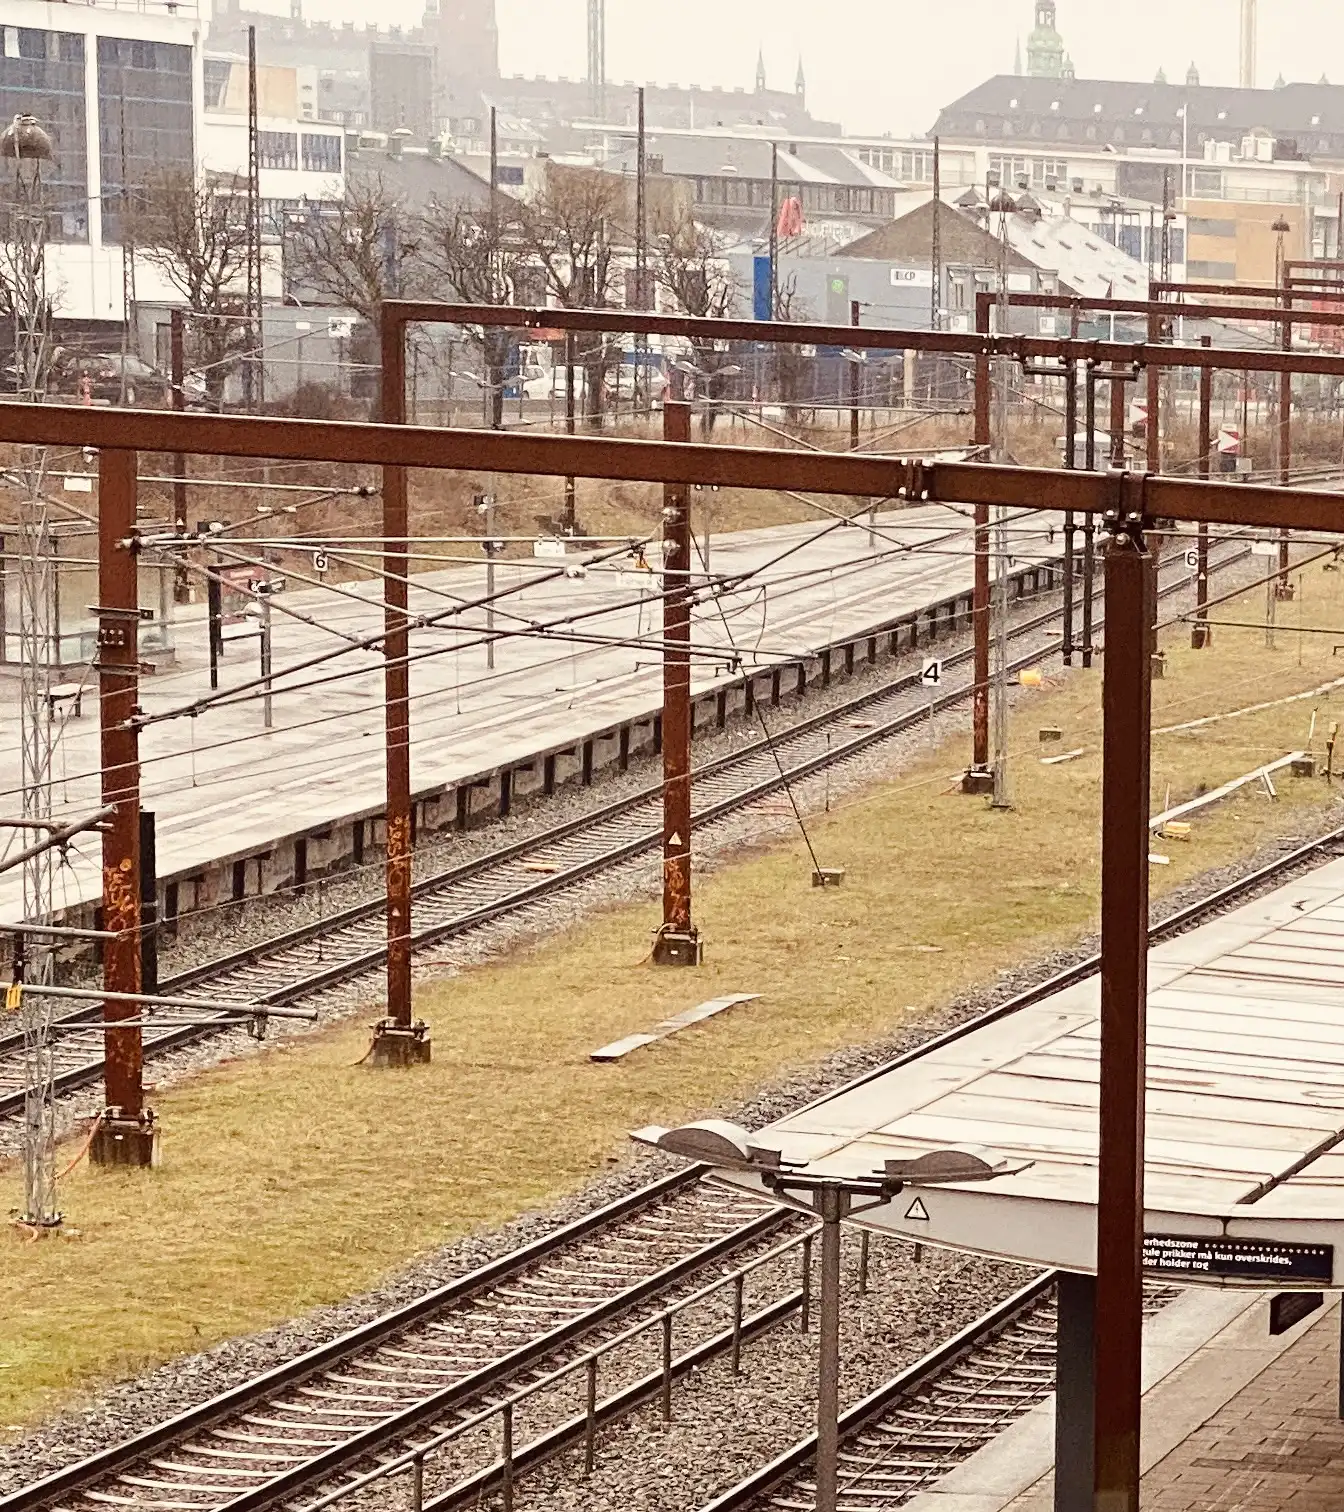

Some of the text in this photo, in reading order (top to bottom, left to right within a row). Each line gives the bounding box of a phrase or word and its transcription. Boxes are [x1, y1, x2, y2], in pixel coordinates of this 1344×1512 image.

[316, 554, 326, 569] 6
[1187, 551, 1198, 567] 6
[923, 662, 940, 683] 4
[1143, 1238, 1199, 1249] erhedszone
[1163, 1249, 1196, 1259] prikker
[1198, 1250, 1212, 1260] må
[1214, 1251, 1234, 1261] kun
[1160, 1258, 1191, 1269] holder
[1192, 1261, 1209, 1270] tog
